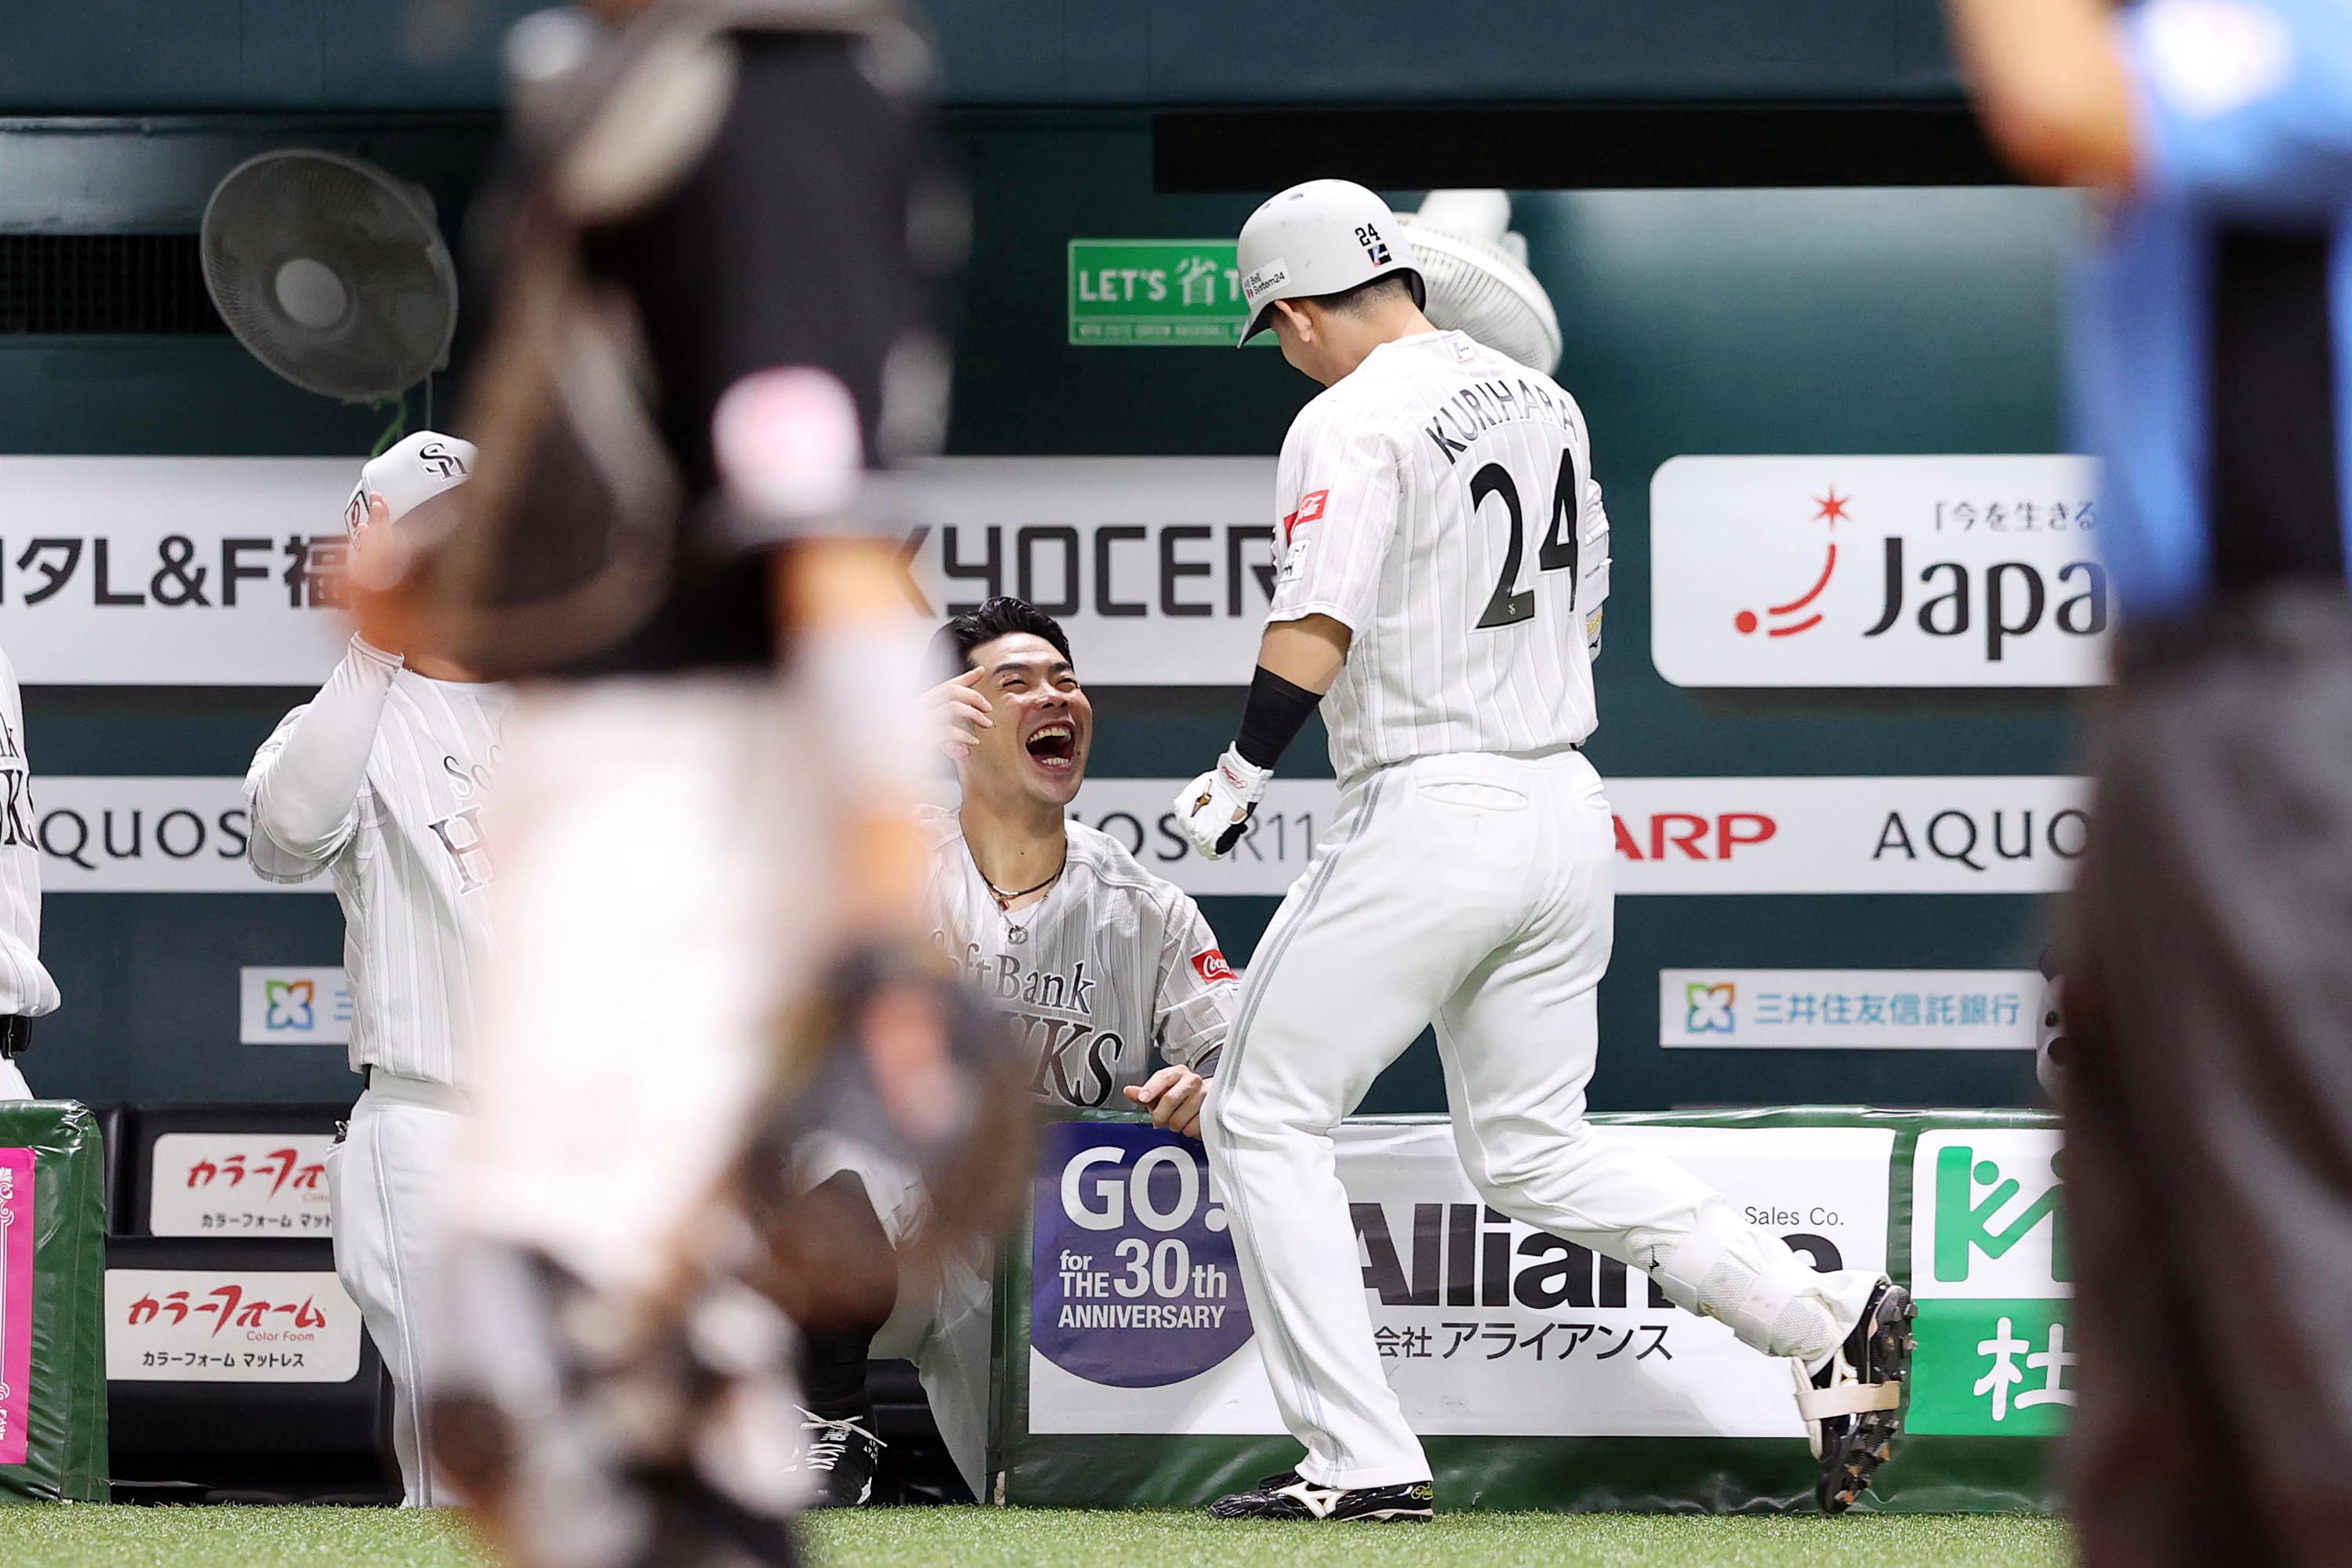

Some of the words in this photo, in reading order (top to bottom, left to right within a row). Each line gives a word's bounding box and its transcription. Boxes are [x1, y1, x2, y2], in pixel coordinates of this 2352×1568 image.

[1355, 223, 1381, 246] 24
[1079, 269, 1167, 302] LET'S
[1425, 378, 1578, 464] KURIHARA
[1469, 447, 1579, 630] 24
[1755, 992, 2022, 1027] 三井住友信託銀行
[1060, 1145, 1229, 1232] GO!
[1744, 1206, 1800, 1226] Sales
[1809, 1207, 1844, 1226] Co.
[1059, 1272, 1109, 1298] THE
[1113, 1238, 1227, 1299] 30th
[1060, 1249, 1092, 1271] for
[1058, 1305, 1225, 1330] ANNIVERSARY
[143, 1351, 235, 1367] カラーフォーム
[243, 1352, 304, 1368] マットレス
